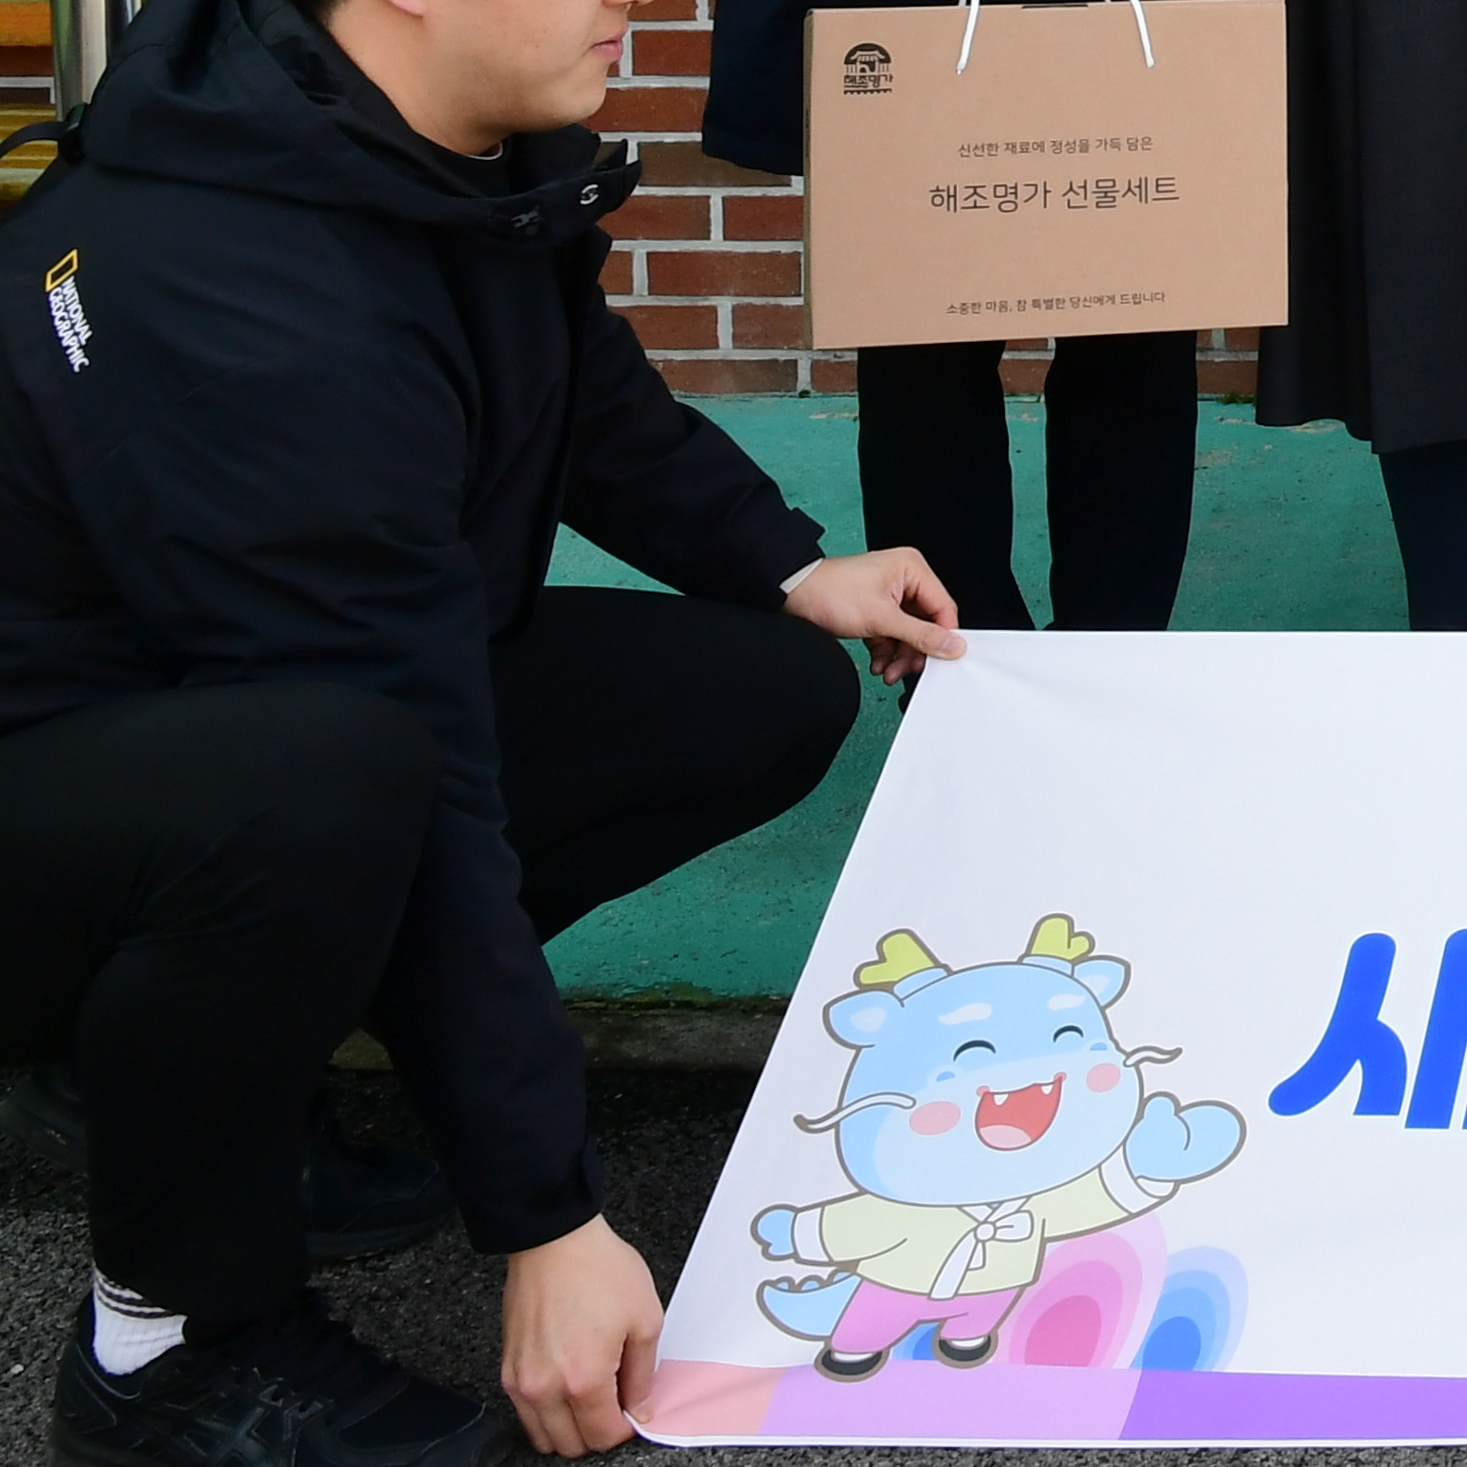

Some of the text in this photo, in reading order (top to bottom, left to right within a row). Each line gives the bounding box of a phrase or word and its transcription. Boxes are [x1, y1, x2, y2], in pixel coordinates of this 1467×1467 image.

[958, 136, 1153, 158] 신선한 재료에 정성을 가득 담은
[929, 176, 1180, 214] 해조명가 선물세트
[62, 275, 94, 346] NATIONAL
[946, 301, 982, 316] 소중한
[1031, 297, 1066, 311] 특별한
[1068, 293, 1116, 310] 당신에게
[1119, 291, 1166, 306] 드립니다
[49, 286, 91, 373] GEOGRAPHIC
